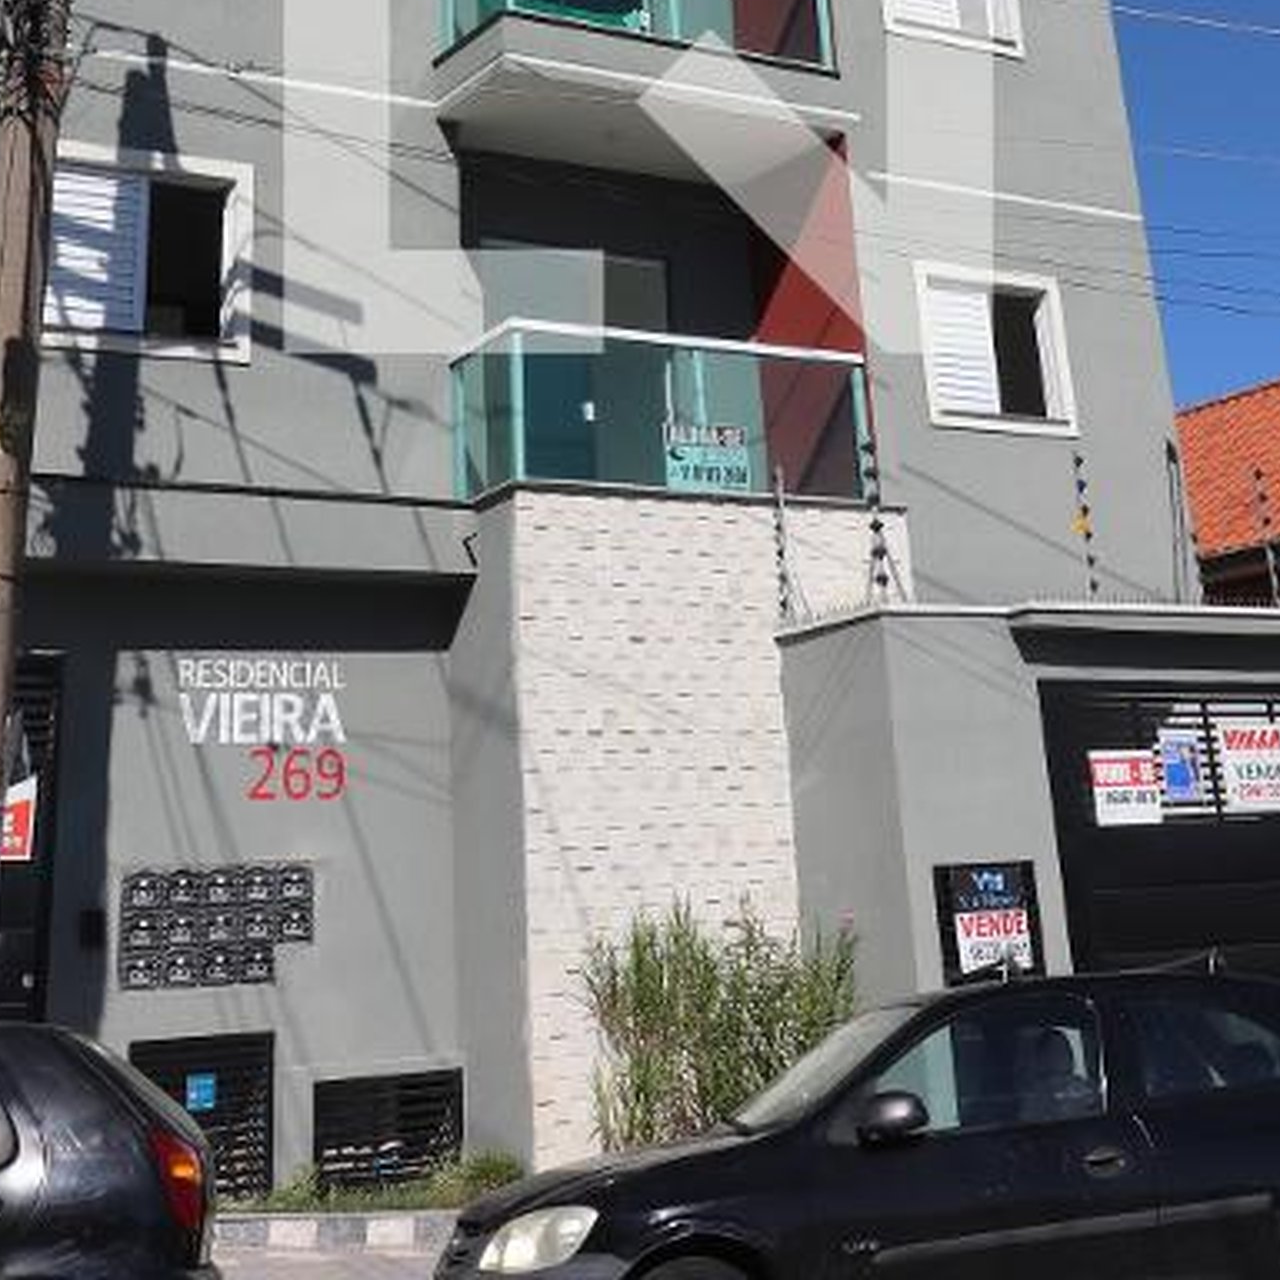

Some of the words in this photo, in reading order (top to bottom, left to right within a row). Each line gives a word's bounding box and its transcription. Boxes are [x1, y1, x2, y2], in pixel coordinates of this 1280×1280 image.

[177, 659, 347, 689] RESIDENCIAL
[179, 693, 347, 745] VIEIRA
[248, 747, 345, 800] 269
[959, 912, 1027, 938] VENDE
